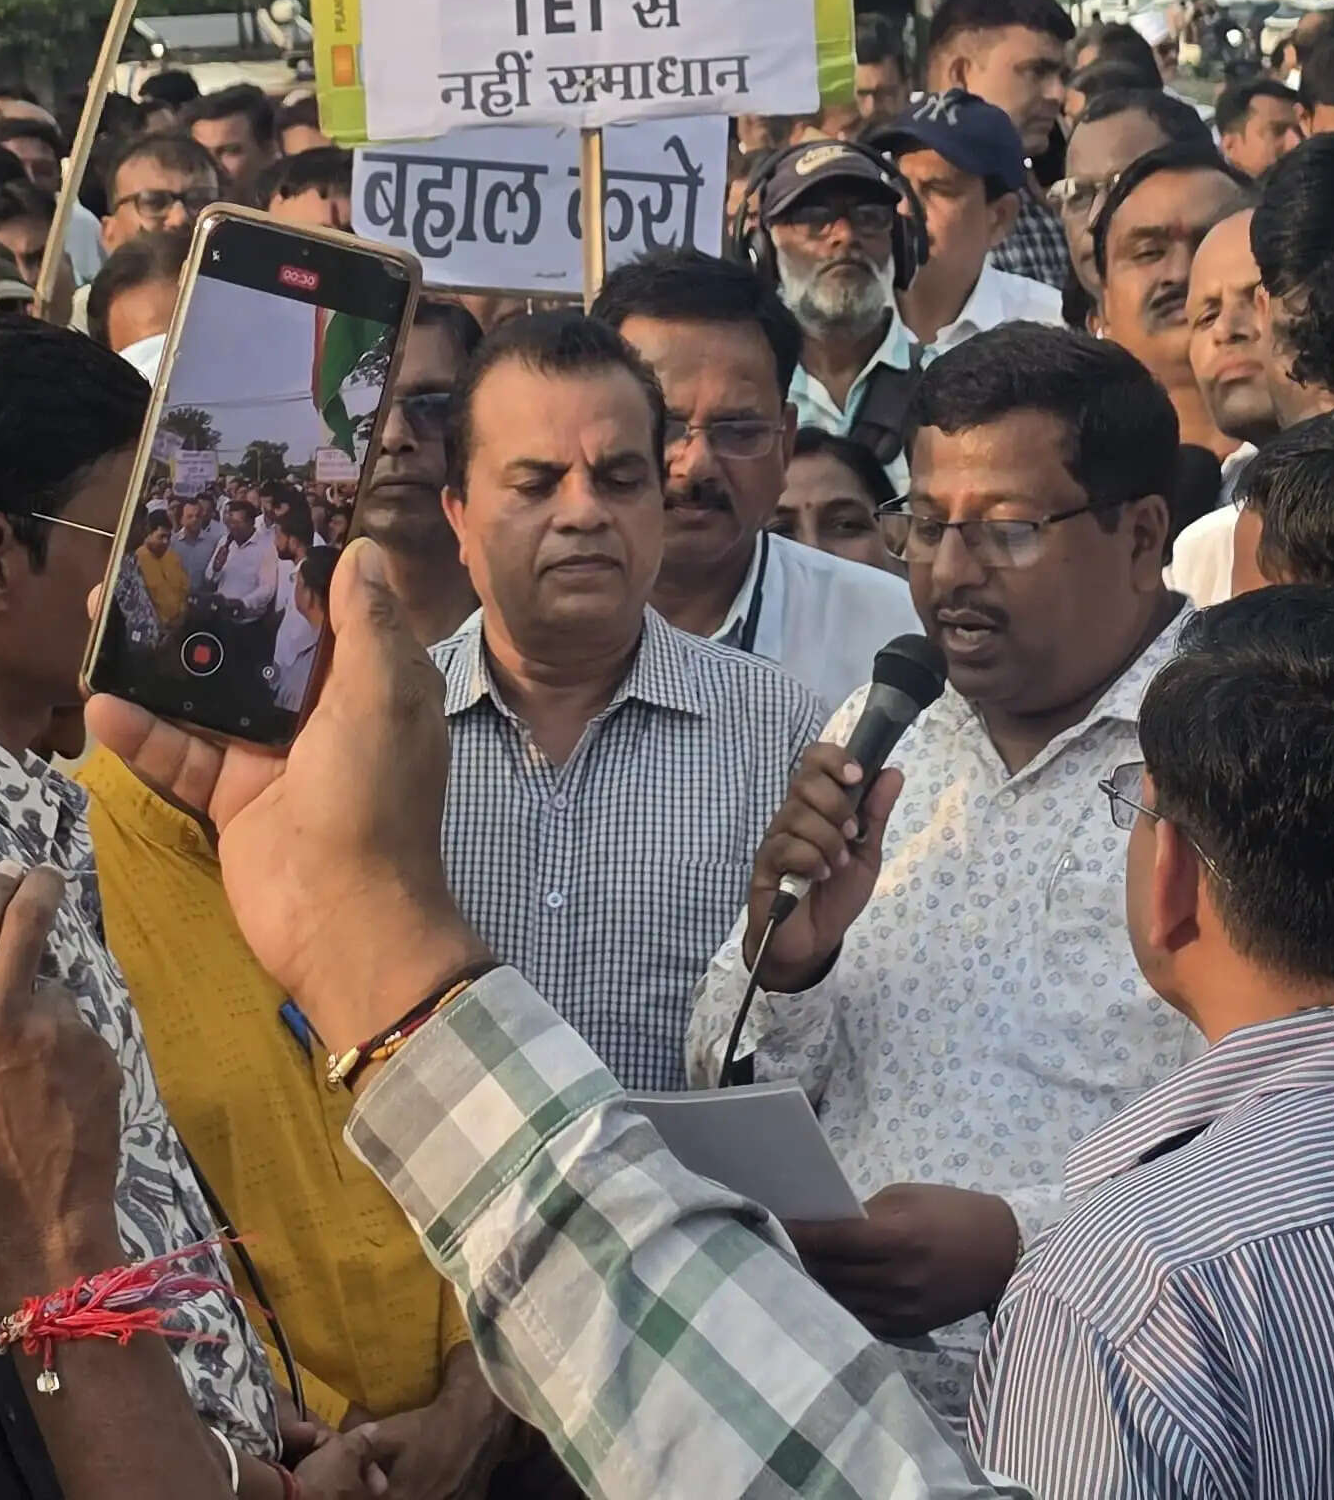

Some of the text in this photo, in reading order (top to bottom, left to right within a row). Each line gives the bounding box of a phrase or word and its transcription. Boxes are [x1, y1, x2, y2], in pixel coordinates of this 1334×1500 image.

[438, 51, 750, 117] नहीं समाधान
[362, 135, 704, 258] बहाल करो
